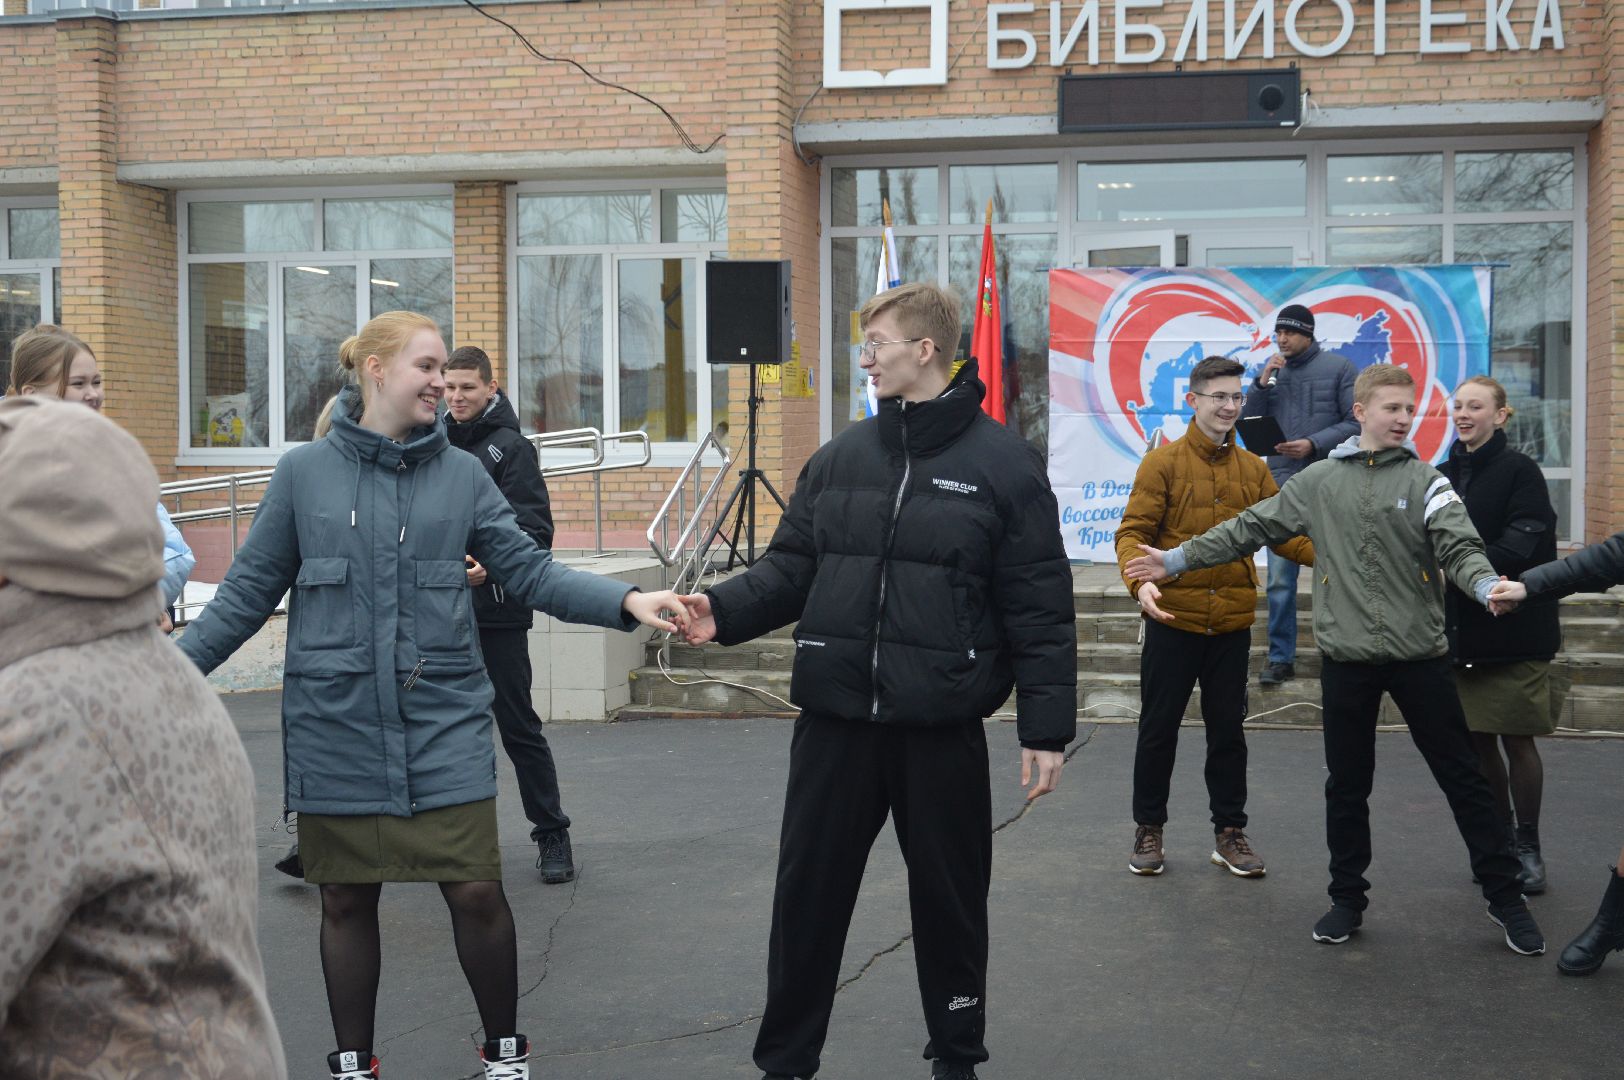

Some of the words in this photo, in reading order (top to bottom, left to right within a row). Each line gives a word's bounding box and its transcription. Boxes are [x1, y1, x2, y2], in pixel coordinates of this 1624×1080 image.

[986, 0, 1565, 70] БИБЛИОТЕКА
[932, 478, 959, 488] WINNER
[960, 483, 978, 492] CLUB
[1082, 481, 1096, 500] В
